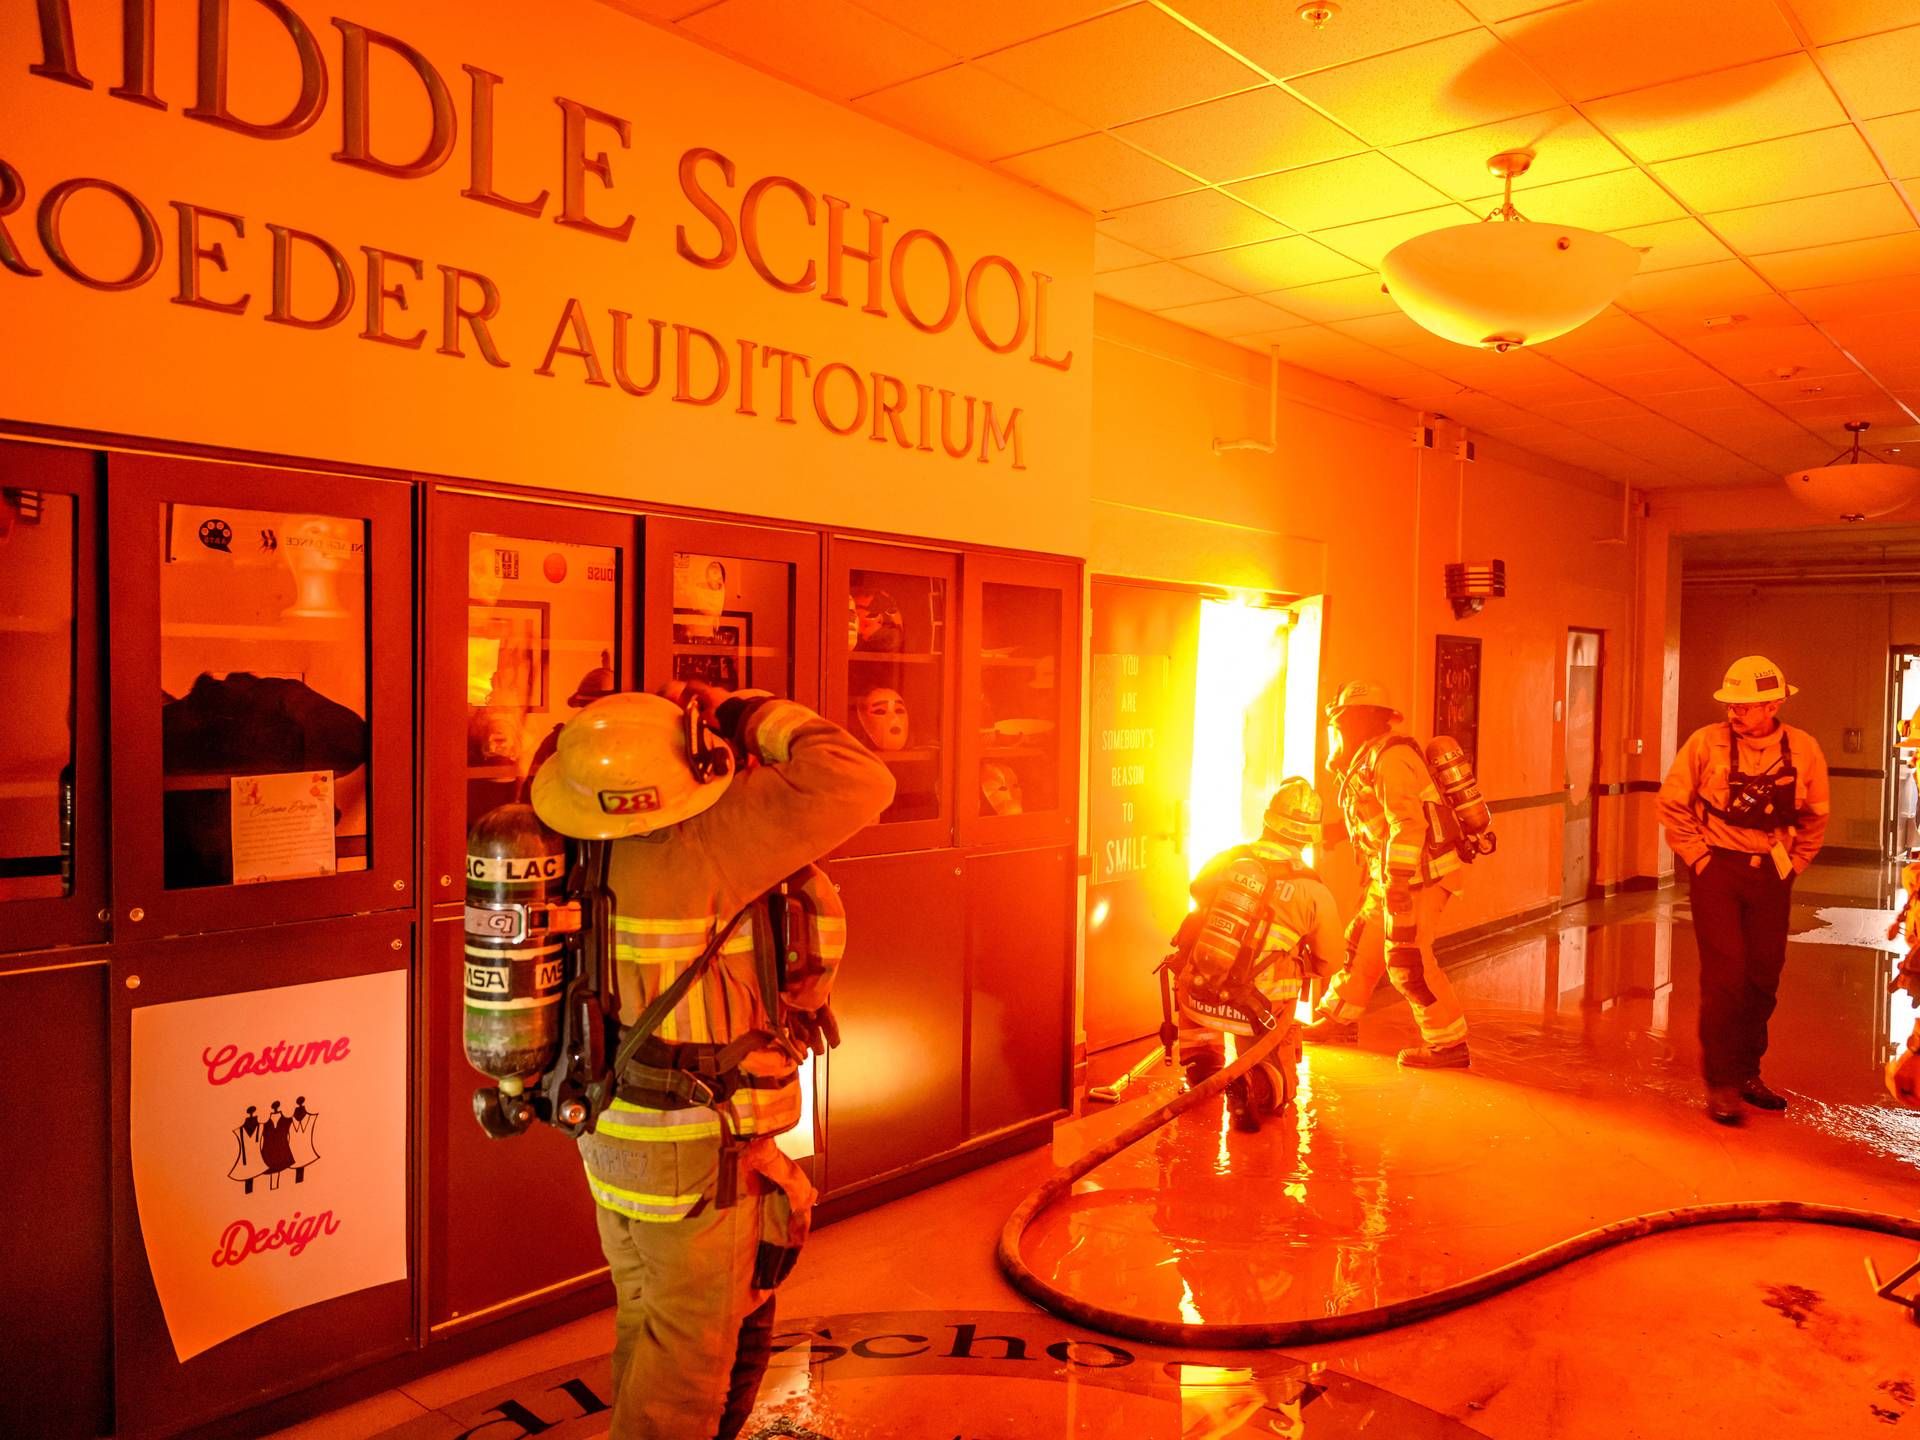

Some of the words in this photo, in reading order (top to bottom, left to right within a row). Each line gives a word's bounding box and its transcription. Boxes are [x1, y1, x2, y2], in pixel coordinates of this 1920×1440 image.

[30, 0, 635, 242] IDDLE
[676, 147, 1073, 372] SCHOOL
[534, 297, 1027, 470] AUDITORIUM
[1121, 655, 1139, 677] YOU
[1121, 692, 1137, 713] ARE
[1102, 728, 1155, 752] SOMEBODY'S
[1111, 765, 1145, 787] REASON
[605, 793, 655, 815] 28
[1121, 802, 1134, 823] TO
[1105, 836, 1148, 875] SMILE
[506, 858, 557, 880] LAC
[202, 1036, 351, 1086] Costume
[211, 1209, 341, 1268] Design
